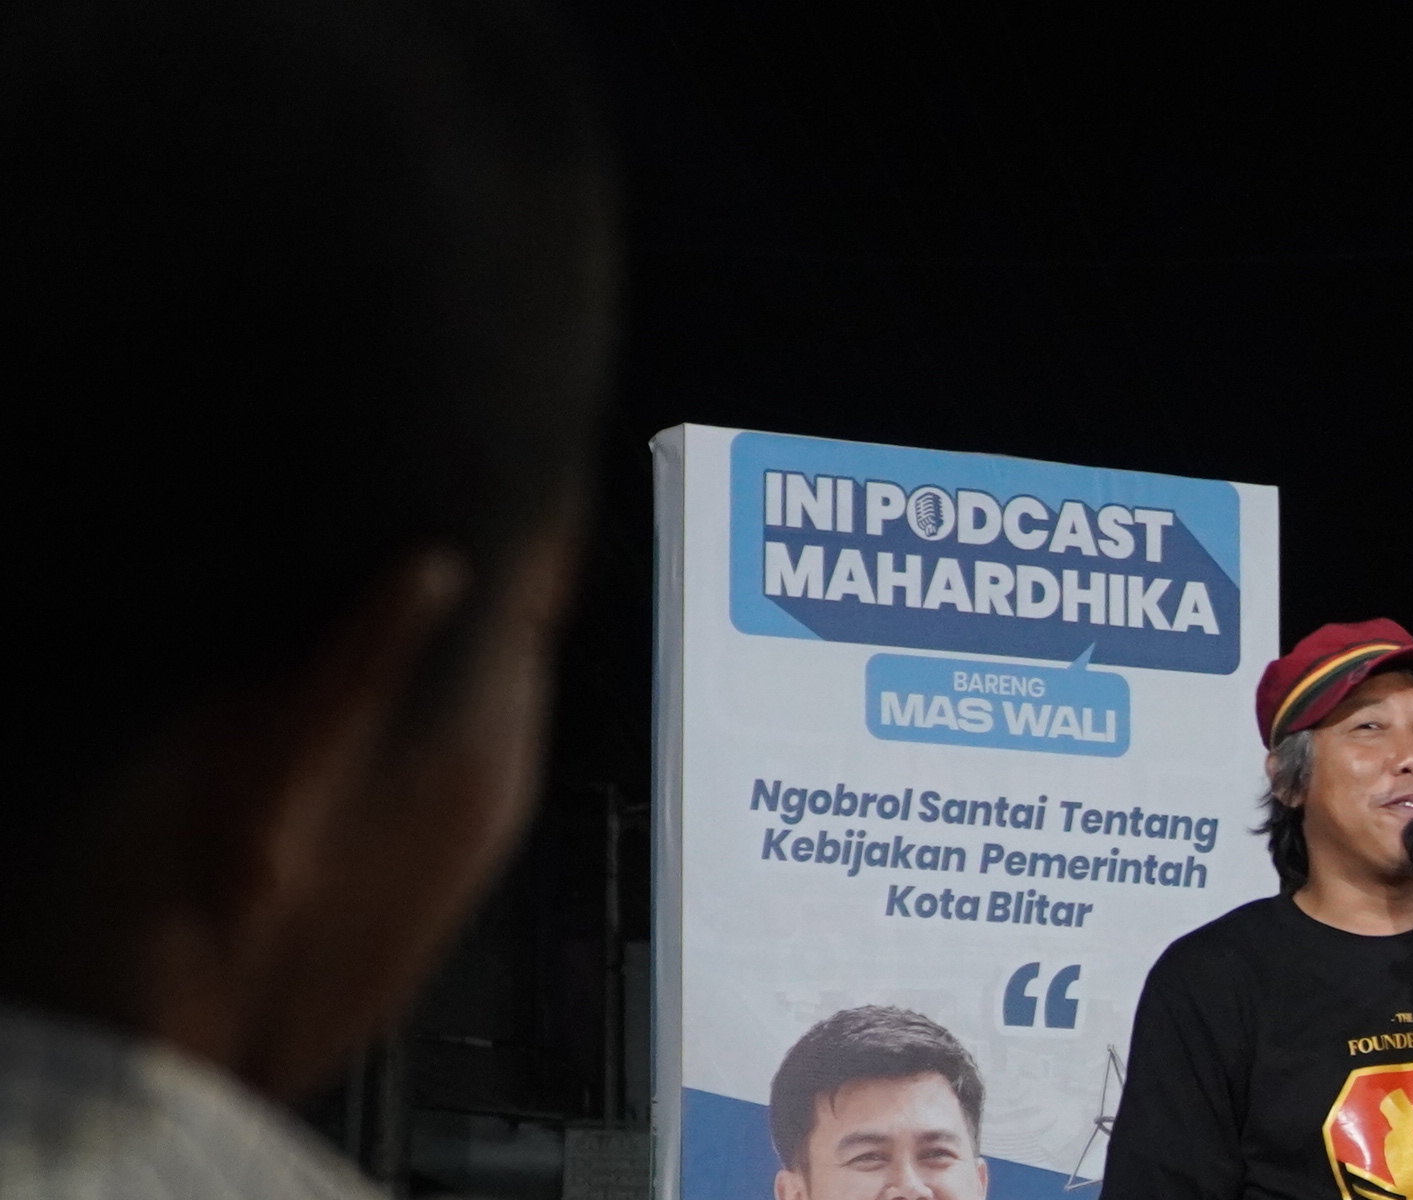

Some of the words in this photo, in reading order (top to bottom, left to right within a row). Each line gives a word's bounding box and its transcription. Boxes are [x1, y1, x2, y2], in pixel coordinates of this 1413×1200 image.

[764, 471, 854, 532] INI
[865, 481, 1174, 562] PODCAST
[765, 542, 1220, 636] MAHARDHIKA
[953, 671, 1045, 698] BARENG
[880, 692, 993, 733] MAS
[1001, 702, 1116, 742] WALI
[750, 779, 911, 825] Ngobrol
[918, 790, 1045, 831] Santai
[1060, 801, 1219, 854] Tentang
[761, 829, 966, 877] Kebijakan
[980, 843, 1207, 888] Pemerintah
[885, 885, 979, 922] Kota
[987, 890, 1093, 928] Blitar
